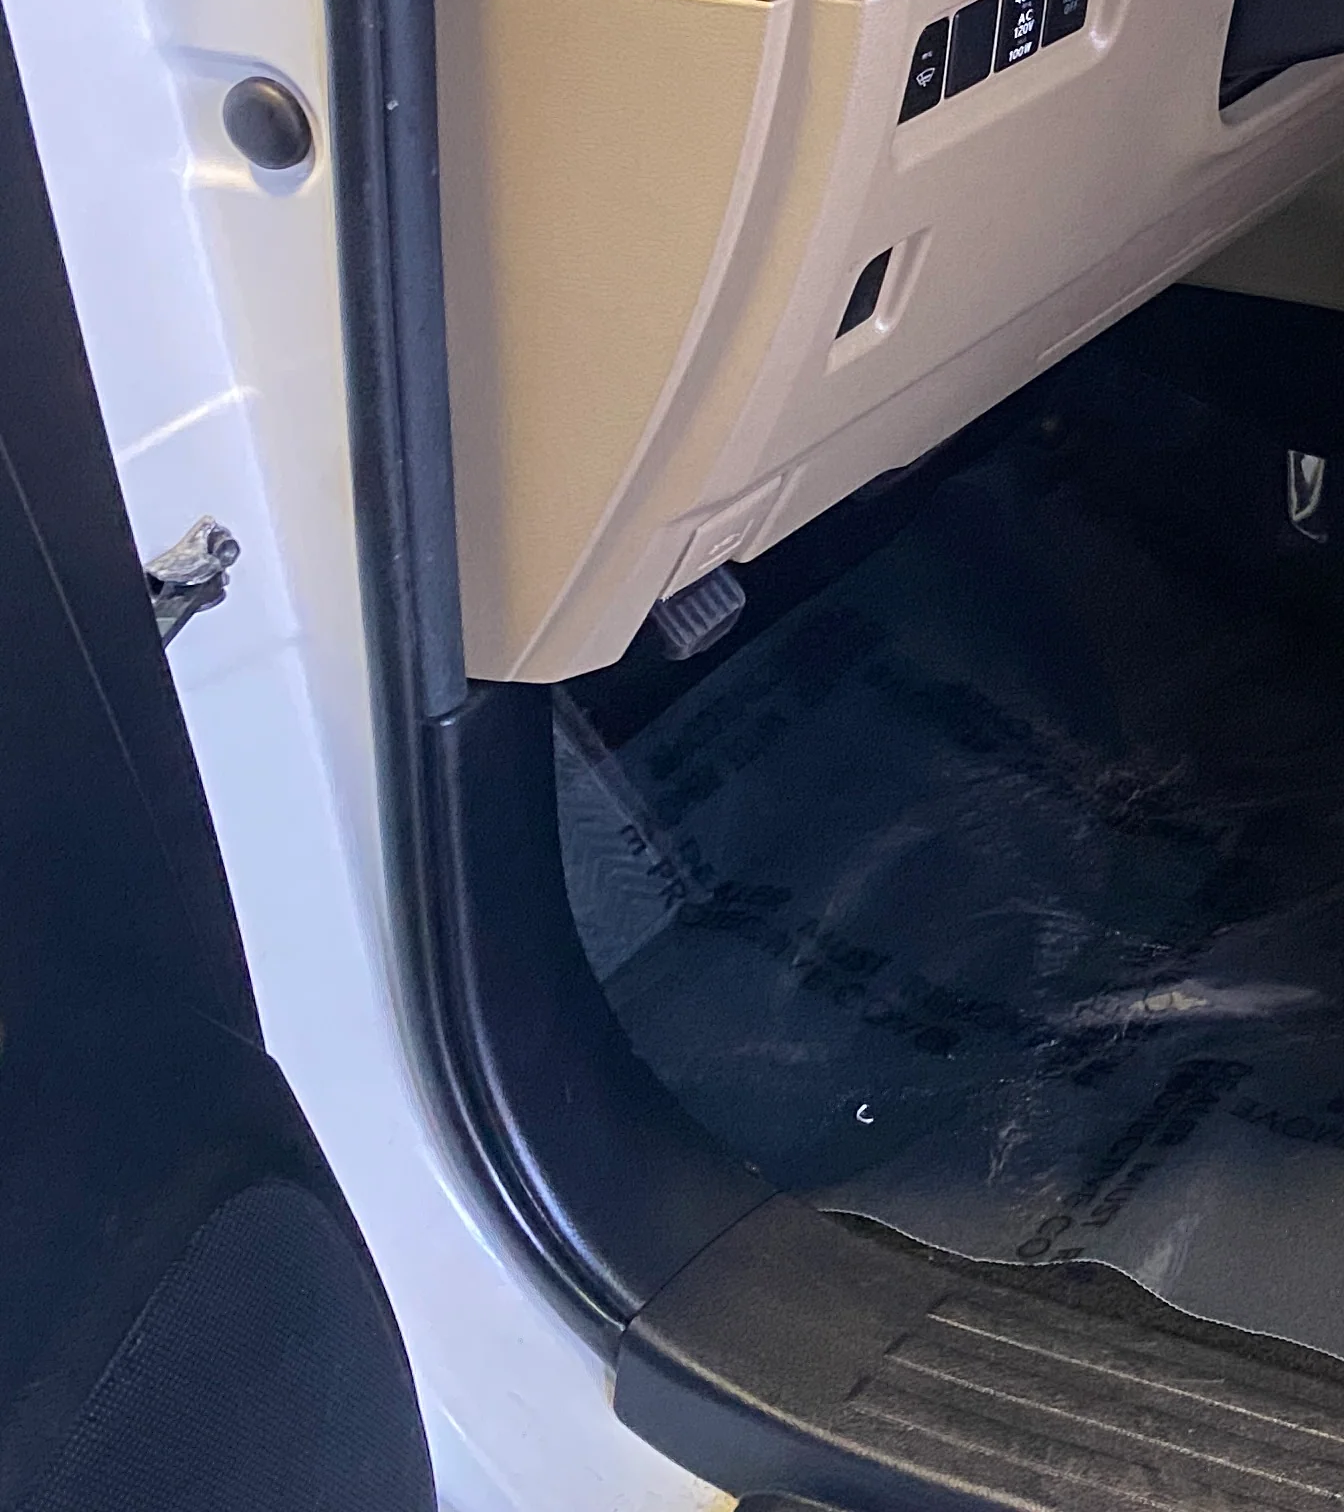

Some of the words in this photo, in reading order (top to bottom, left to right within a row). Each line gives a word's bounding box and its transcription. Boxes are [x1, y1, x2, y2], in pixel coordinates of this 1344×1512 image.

[1018, 9, 1033, 25] AC
[1014, 19, 1035, 38] 120V
[1009, 42, 1032, 62] 100W
